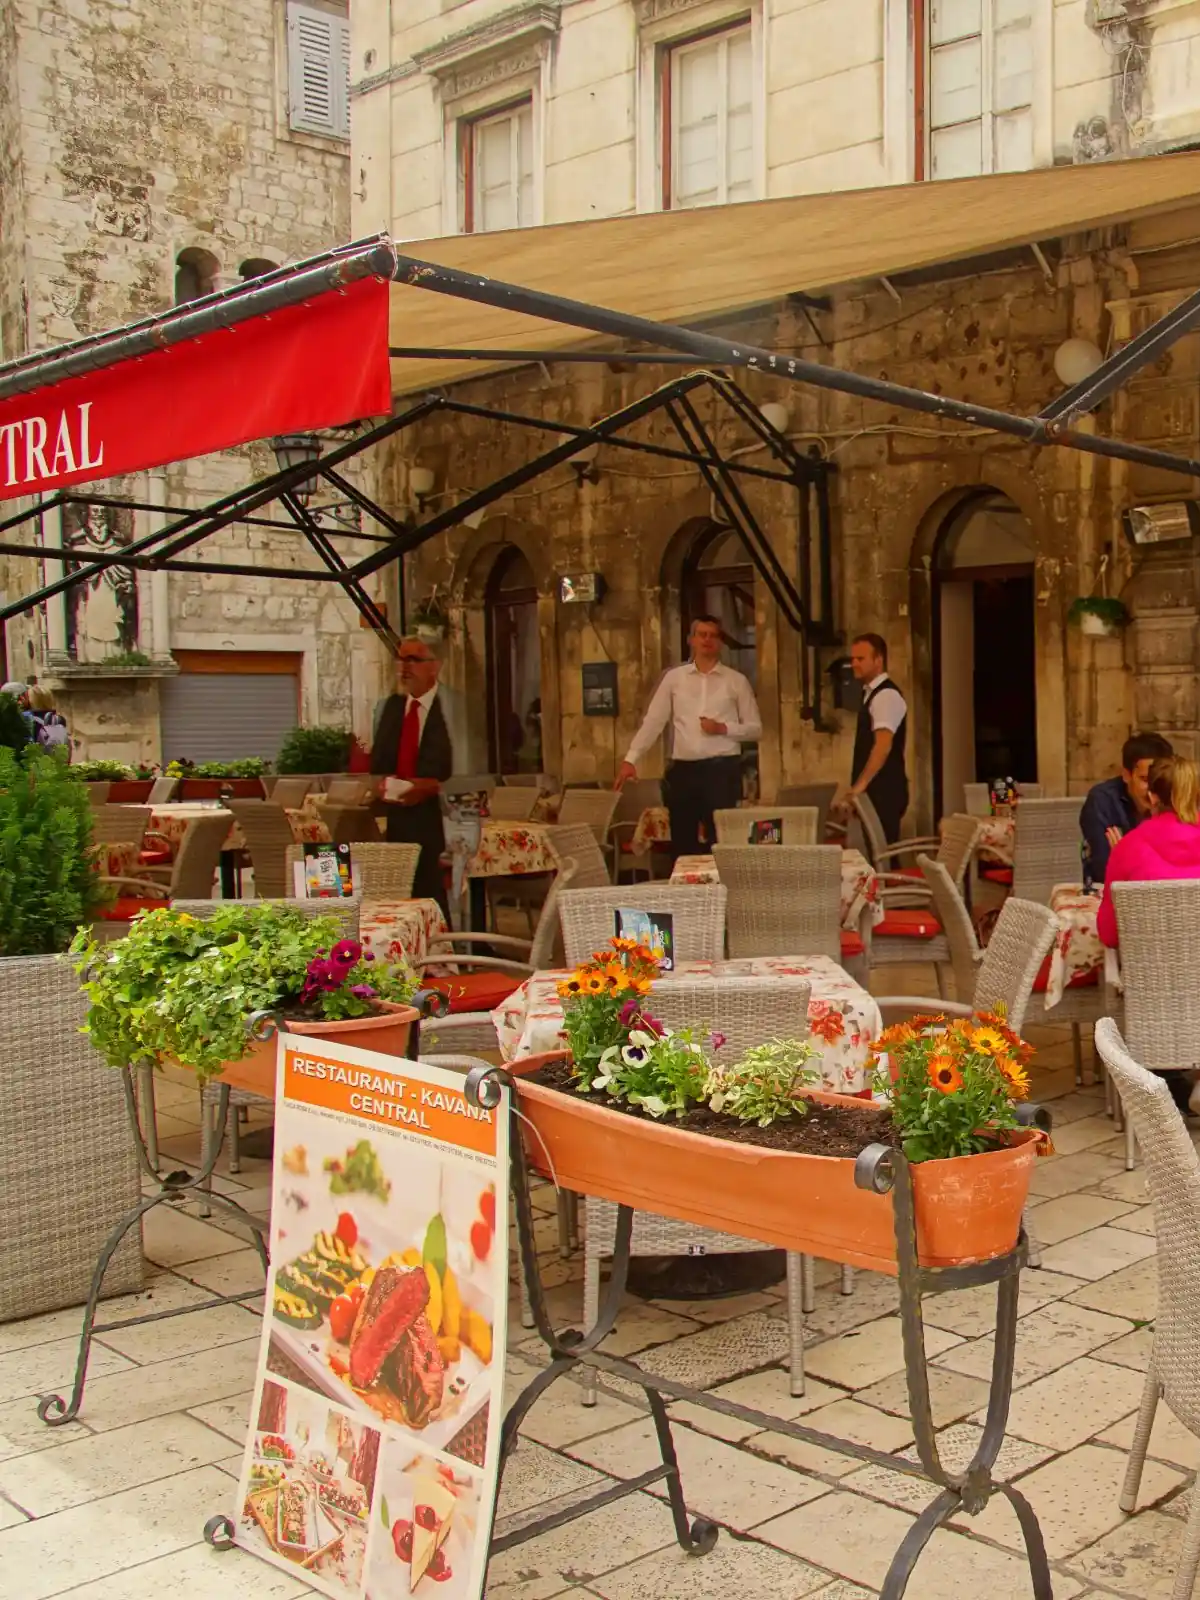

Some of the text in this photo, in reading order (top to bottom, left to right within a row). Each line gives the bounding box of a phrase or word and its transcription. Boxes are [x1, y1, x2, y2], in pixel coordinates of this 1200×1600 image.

[0, 402, 104, 487] TRAL
[292, 1057, 407, 1099] RESTAURANT
[420, 1087, 493, 1125] KAVANA
[350, 1092, 431, 1130] CENTRAL
